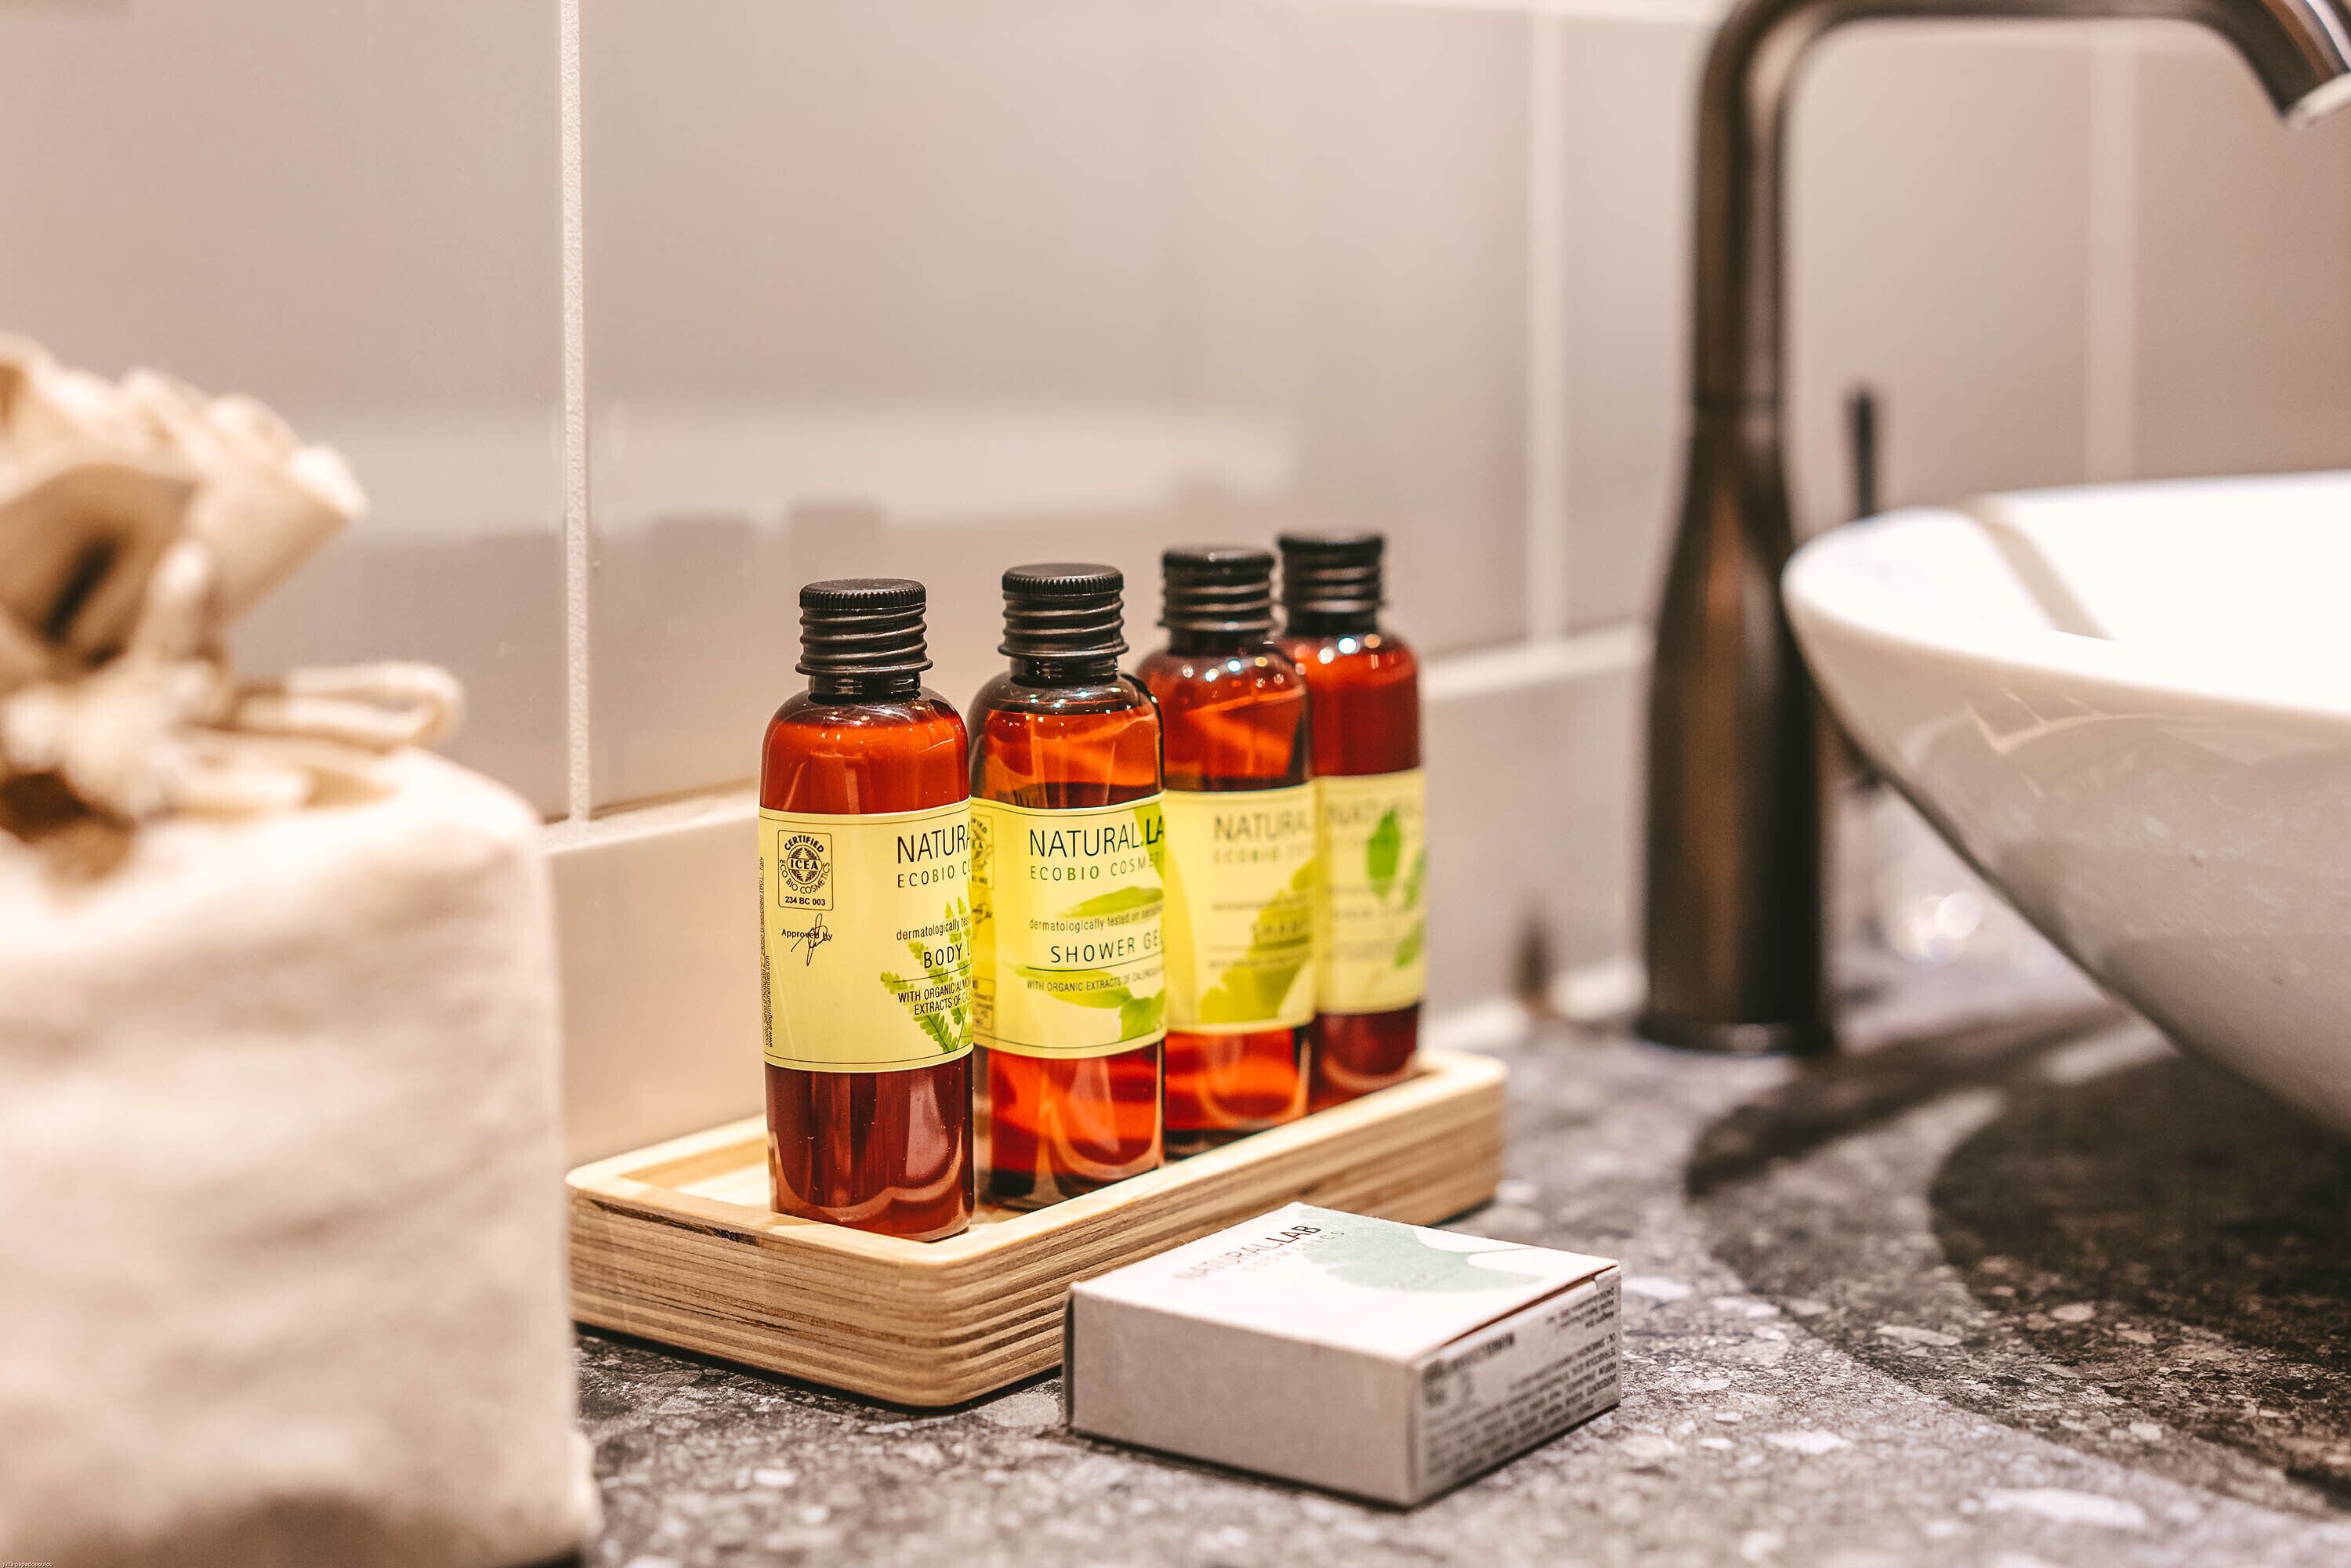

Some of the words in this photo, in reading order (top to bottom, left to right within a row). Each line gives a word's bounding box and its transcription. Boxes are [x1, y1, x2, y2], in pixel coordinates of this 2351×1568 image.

[784, 835, 824, 853] CERTIFIED
[790, 859, 819, 870] ICEA
[1031, 865, 1099, 882] ECOBIO
[786, 878, 799, 892] BIO
[897, 864, 955, 889] ECOBIO
[784, 896, 798, 904] 234
[896, 919, 960, 941] dermatologically
[1029, 918, 1104, 934] dermatologically
[1107, 911, 1130, 929] tested
[781, 928, 820, 940] Approved
[923, 943, 963, 969] BODY
[1050, 936, 1136, 964] SHOWER
[897, 990, 921, 1004] WITH
[924, 982, 955, 1001] ORGANIC
[1027, 979, 1045, 991] WITH
[1047, 979, 1084, 992] ORGANIC
[1086, 976, 1122, 992] EXTRACTS
[914, 997, 953, 1016] EXTRACTS
[954, 994, 962, 1007] OF
